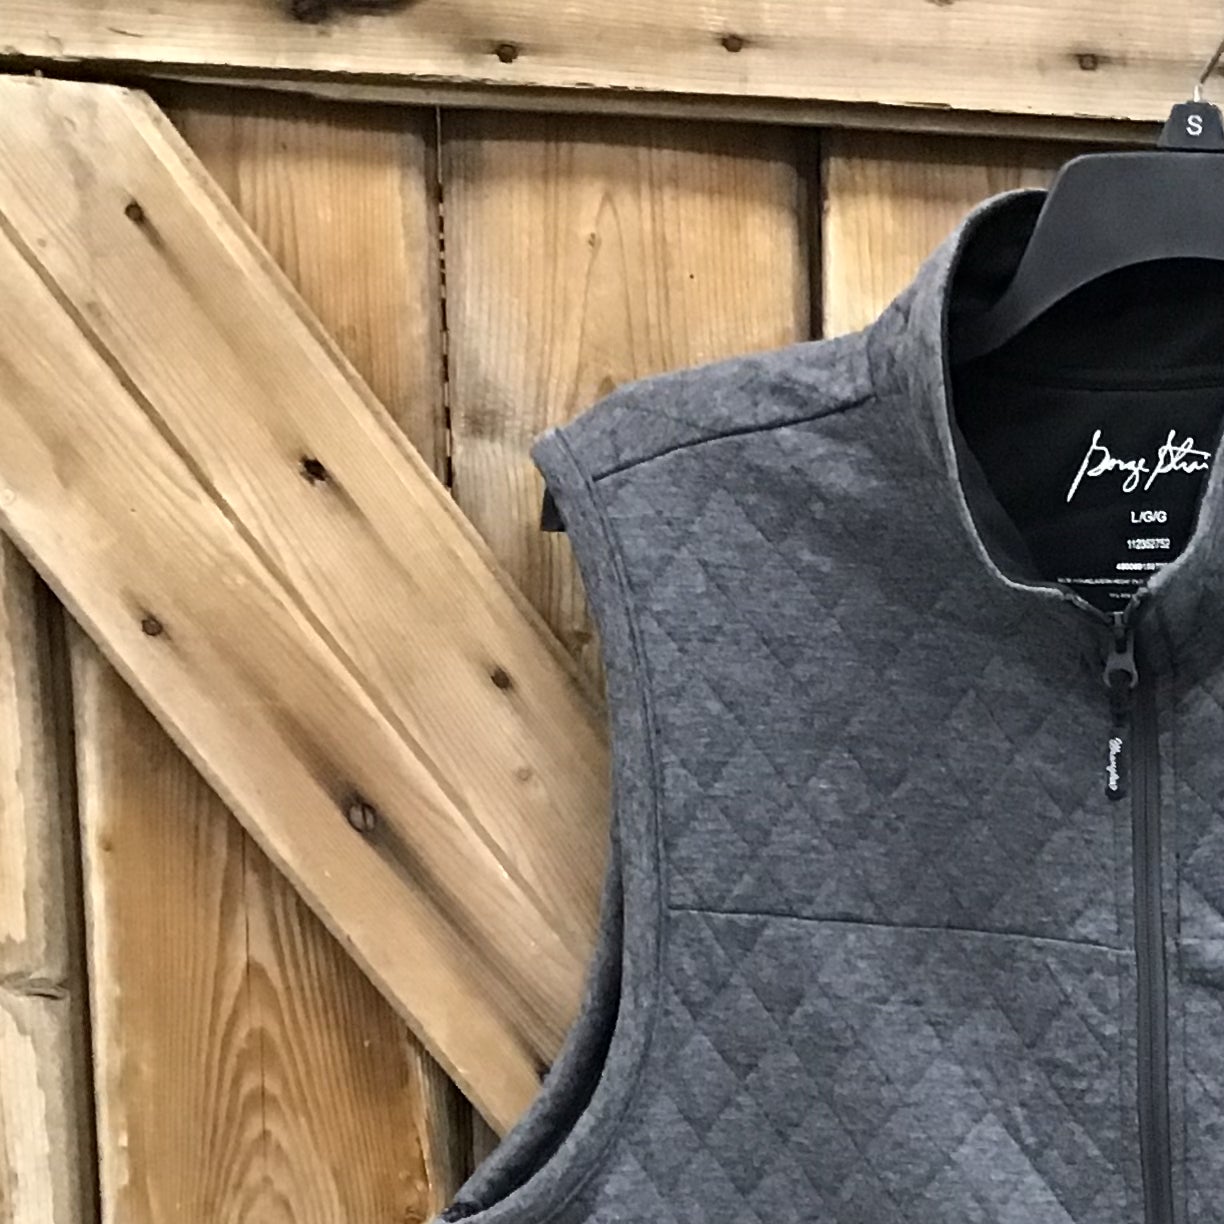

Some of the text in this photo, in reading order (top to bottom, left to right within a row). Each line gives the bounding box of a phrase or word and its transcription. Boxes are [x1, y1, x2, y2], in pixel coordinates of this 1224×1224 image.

[1186, 115, 1203, 136] S
[1144, 429, 1211, 491] Strai
[1130, 510, 1168, 524] L/G/G
